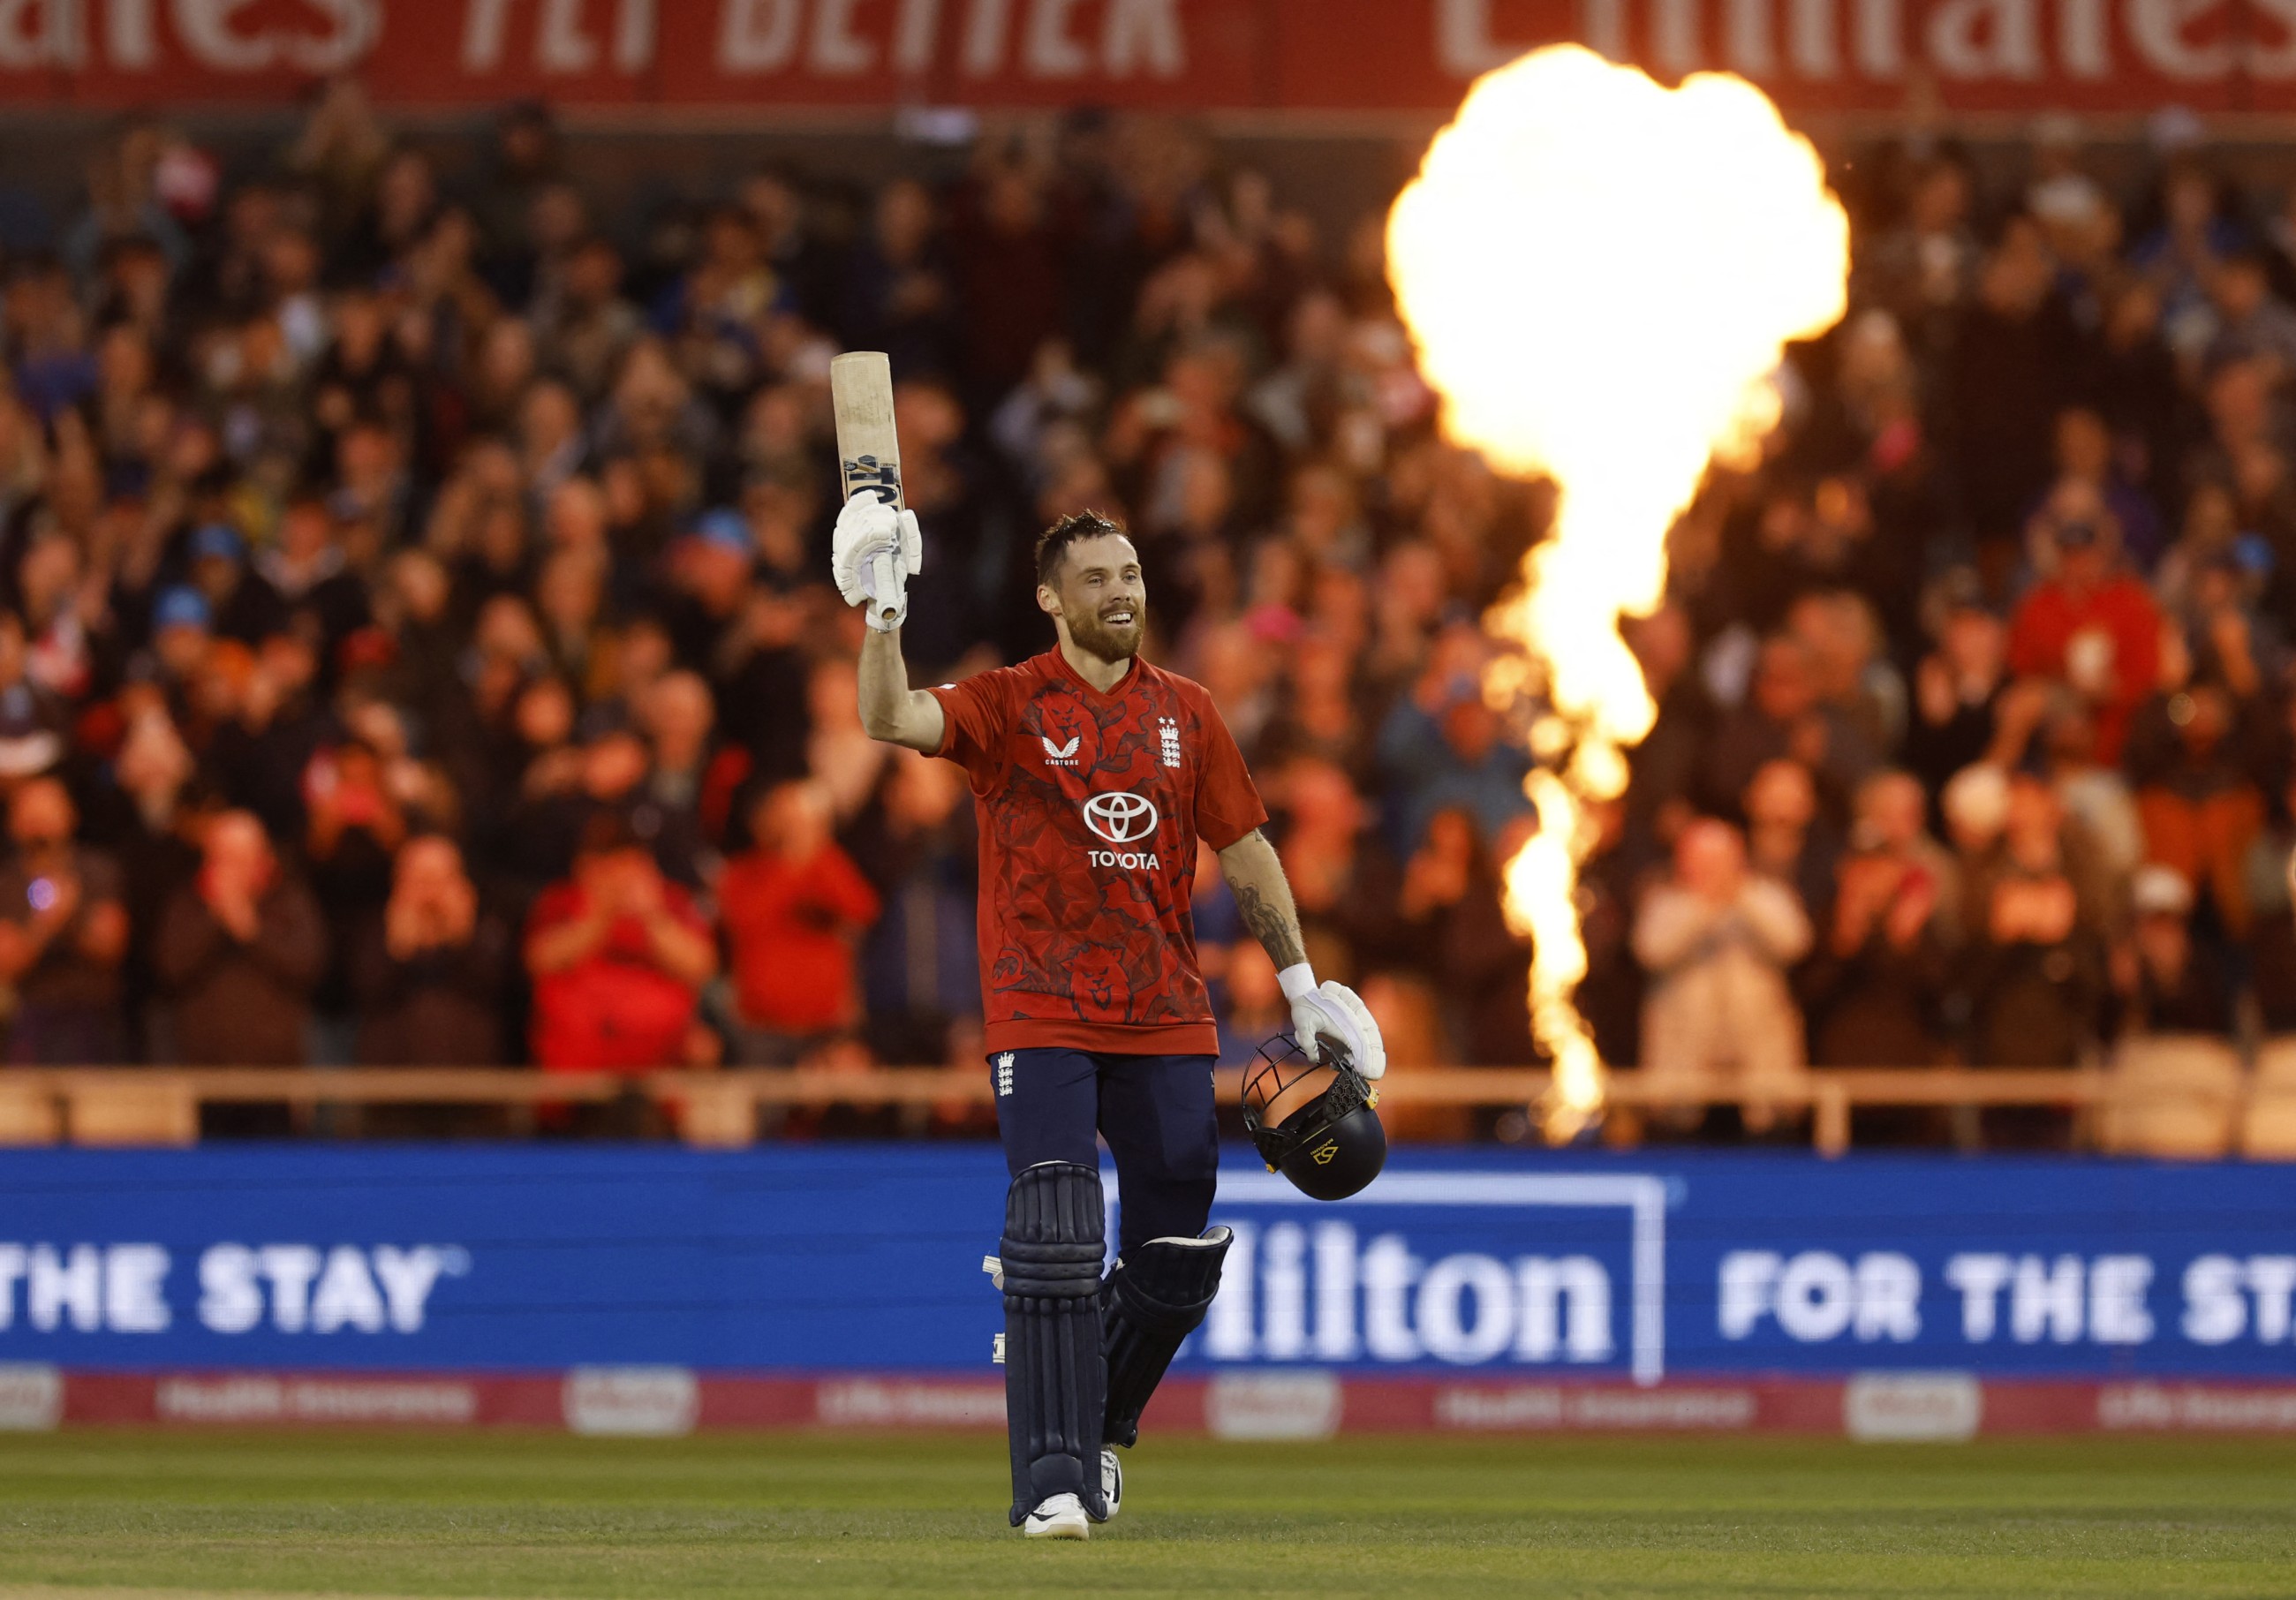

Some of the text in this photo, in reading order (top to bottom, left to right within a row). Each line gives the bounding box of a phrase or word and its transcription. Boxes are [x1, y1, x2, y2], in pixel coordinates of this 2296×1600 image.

[1088, 850, 1160, 871] TOYOTA
[198, 1242, 442, 1334] STAY
[1718, 1250, 1922, 1343] FOR
[1945, 1253, 2156, 1344] THE
